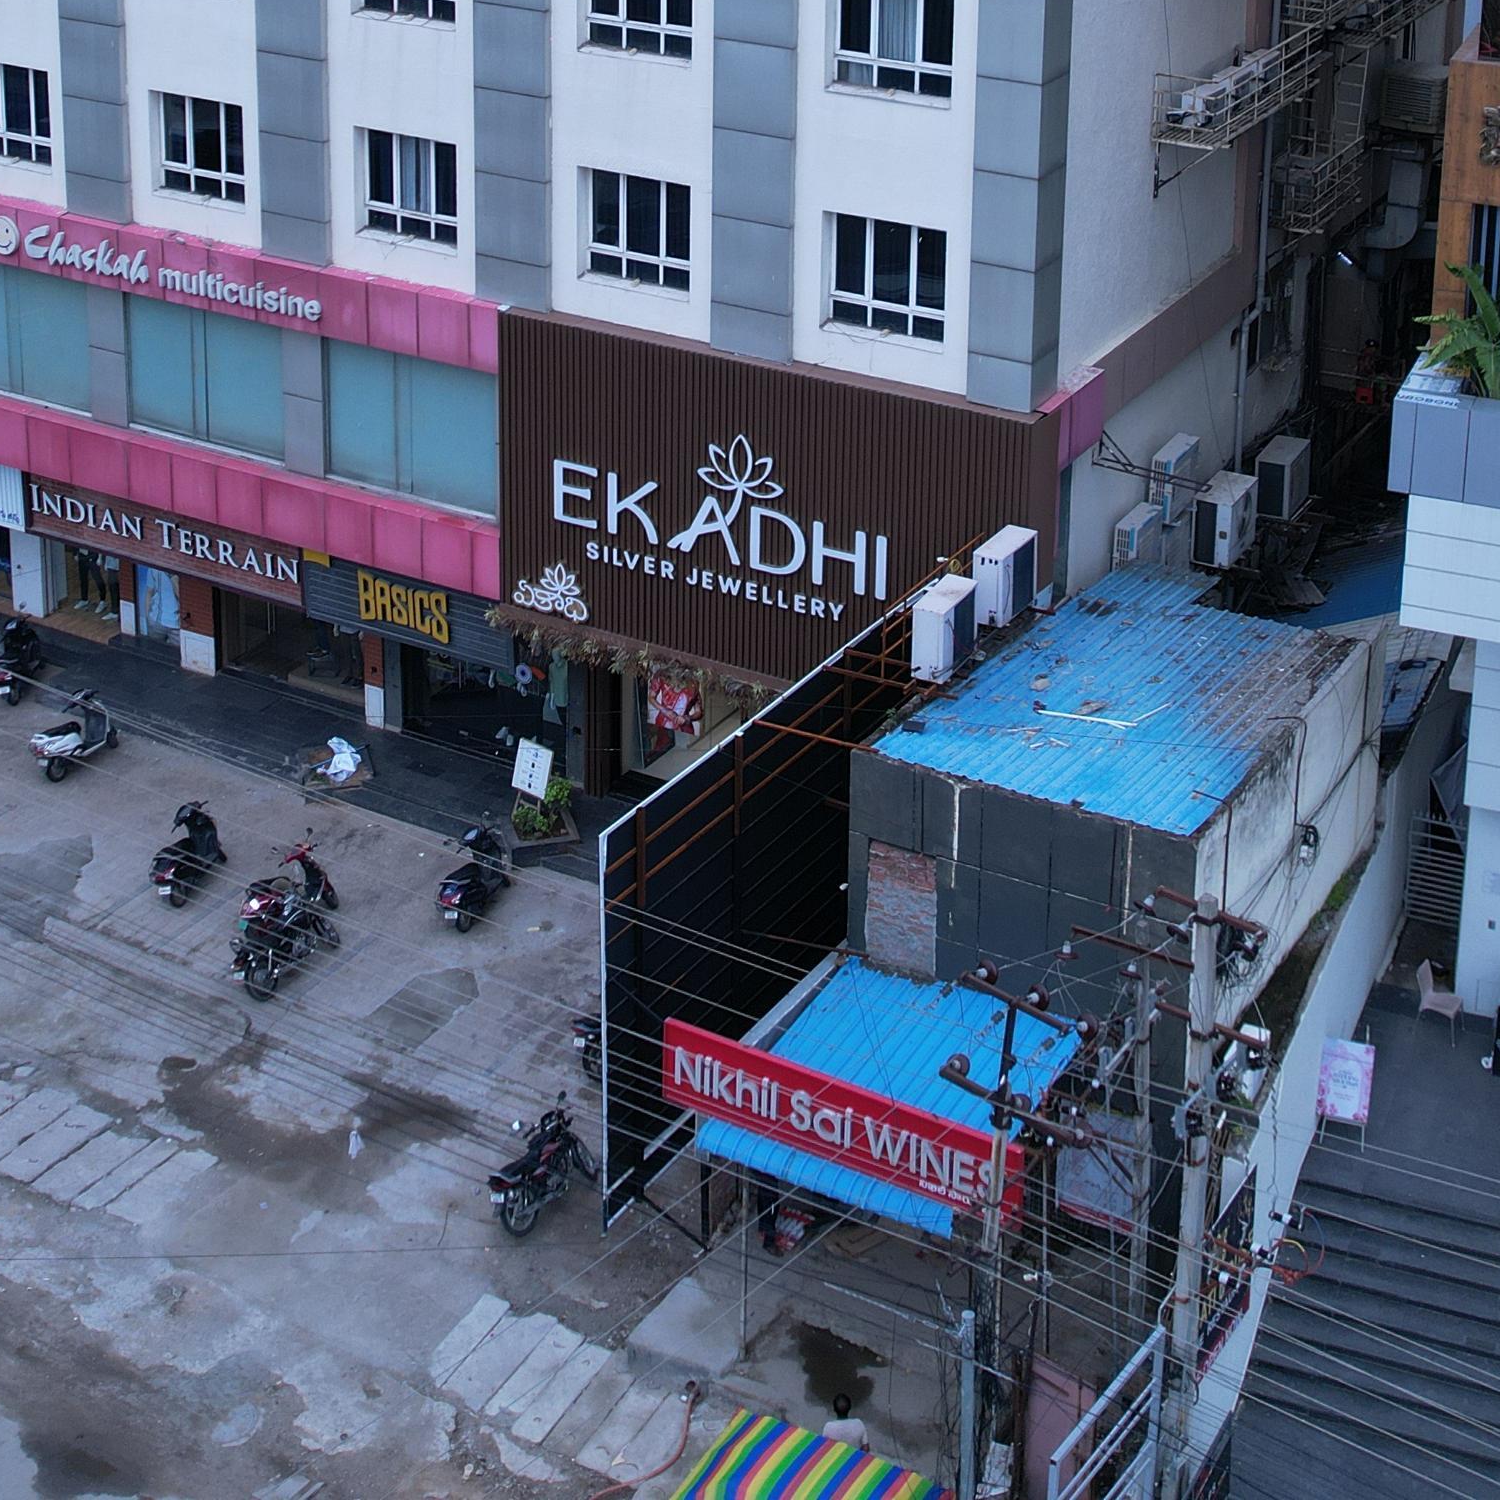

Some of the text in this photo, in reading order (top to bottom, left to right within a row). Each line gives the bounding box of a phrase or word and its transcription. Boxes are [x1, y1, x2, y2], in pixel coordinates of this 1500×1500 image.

[23, 224, 323, 322] Chaskah multicuisine
[29, 483, 299, 584] INDIAN TERRAIN
[586, 542, 845, 622] SILVER JEWELLERY
[357, 568, 450, 644] BASICS
[674, 1046, 1001, 1198] Nikhil Sai WINES
